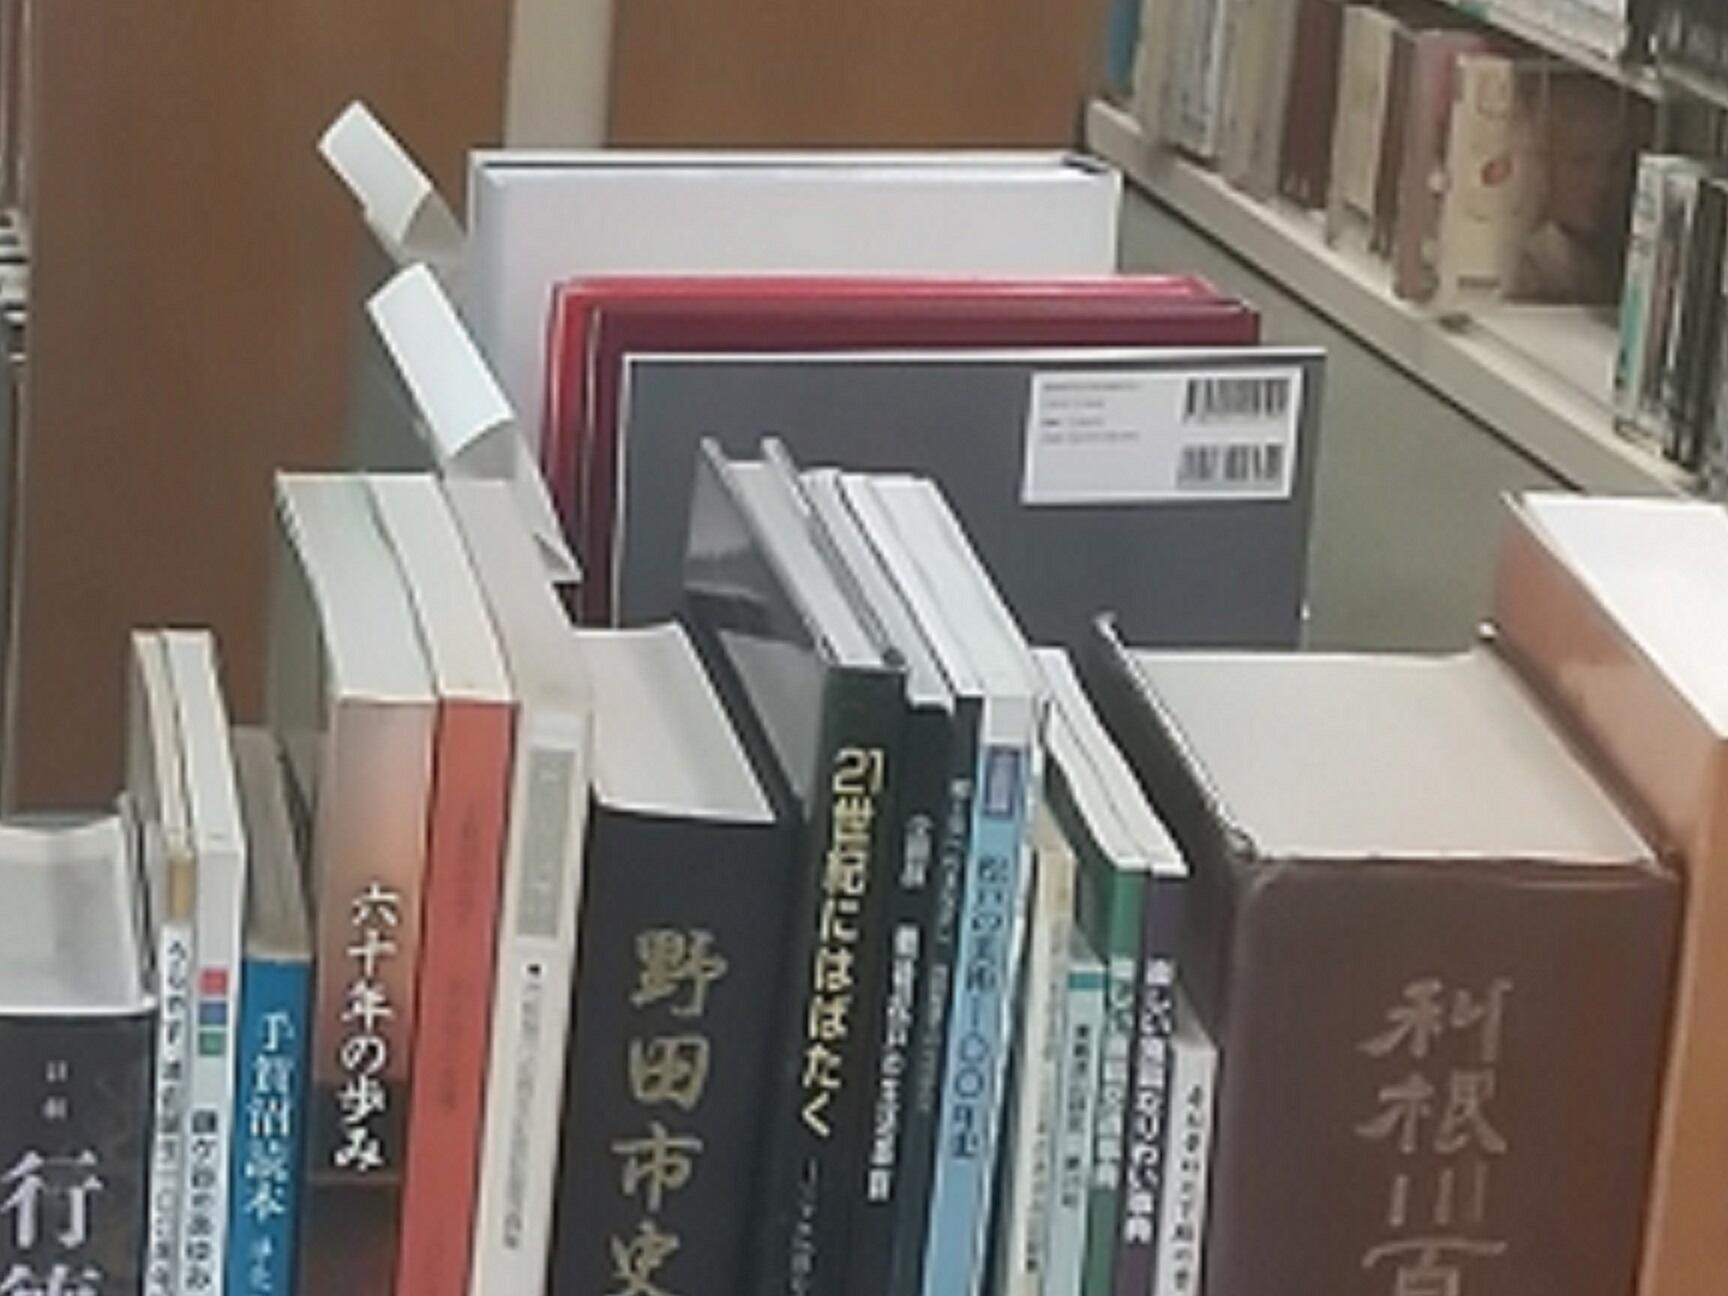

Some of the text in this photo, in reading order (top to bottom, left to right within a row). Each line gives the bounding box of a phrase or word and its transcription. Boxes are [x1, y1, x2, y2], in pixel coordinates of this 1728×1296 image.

[334, 882, 402, 1173] 六十年の歩み
[801, 748, 885, 1137] 21世紀にはばたく
